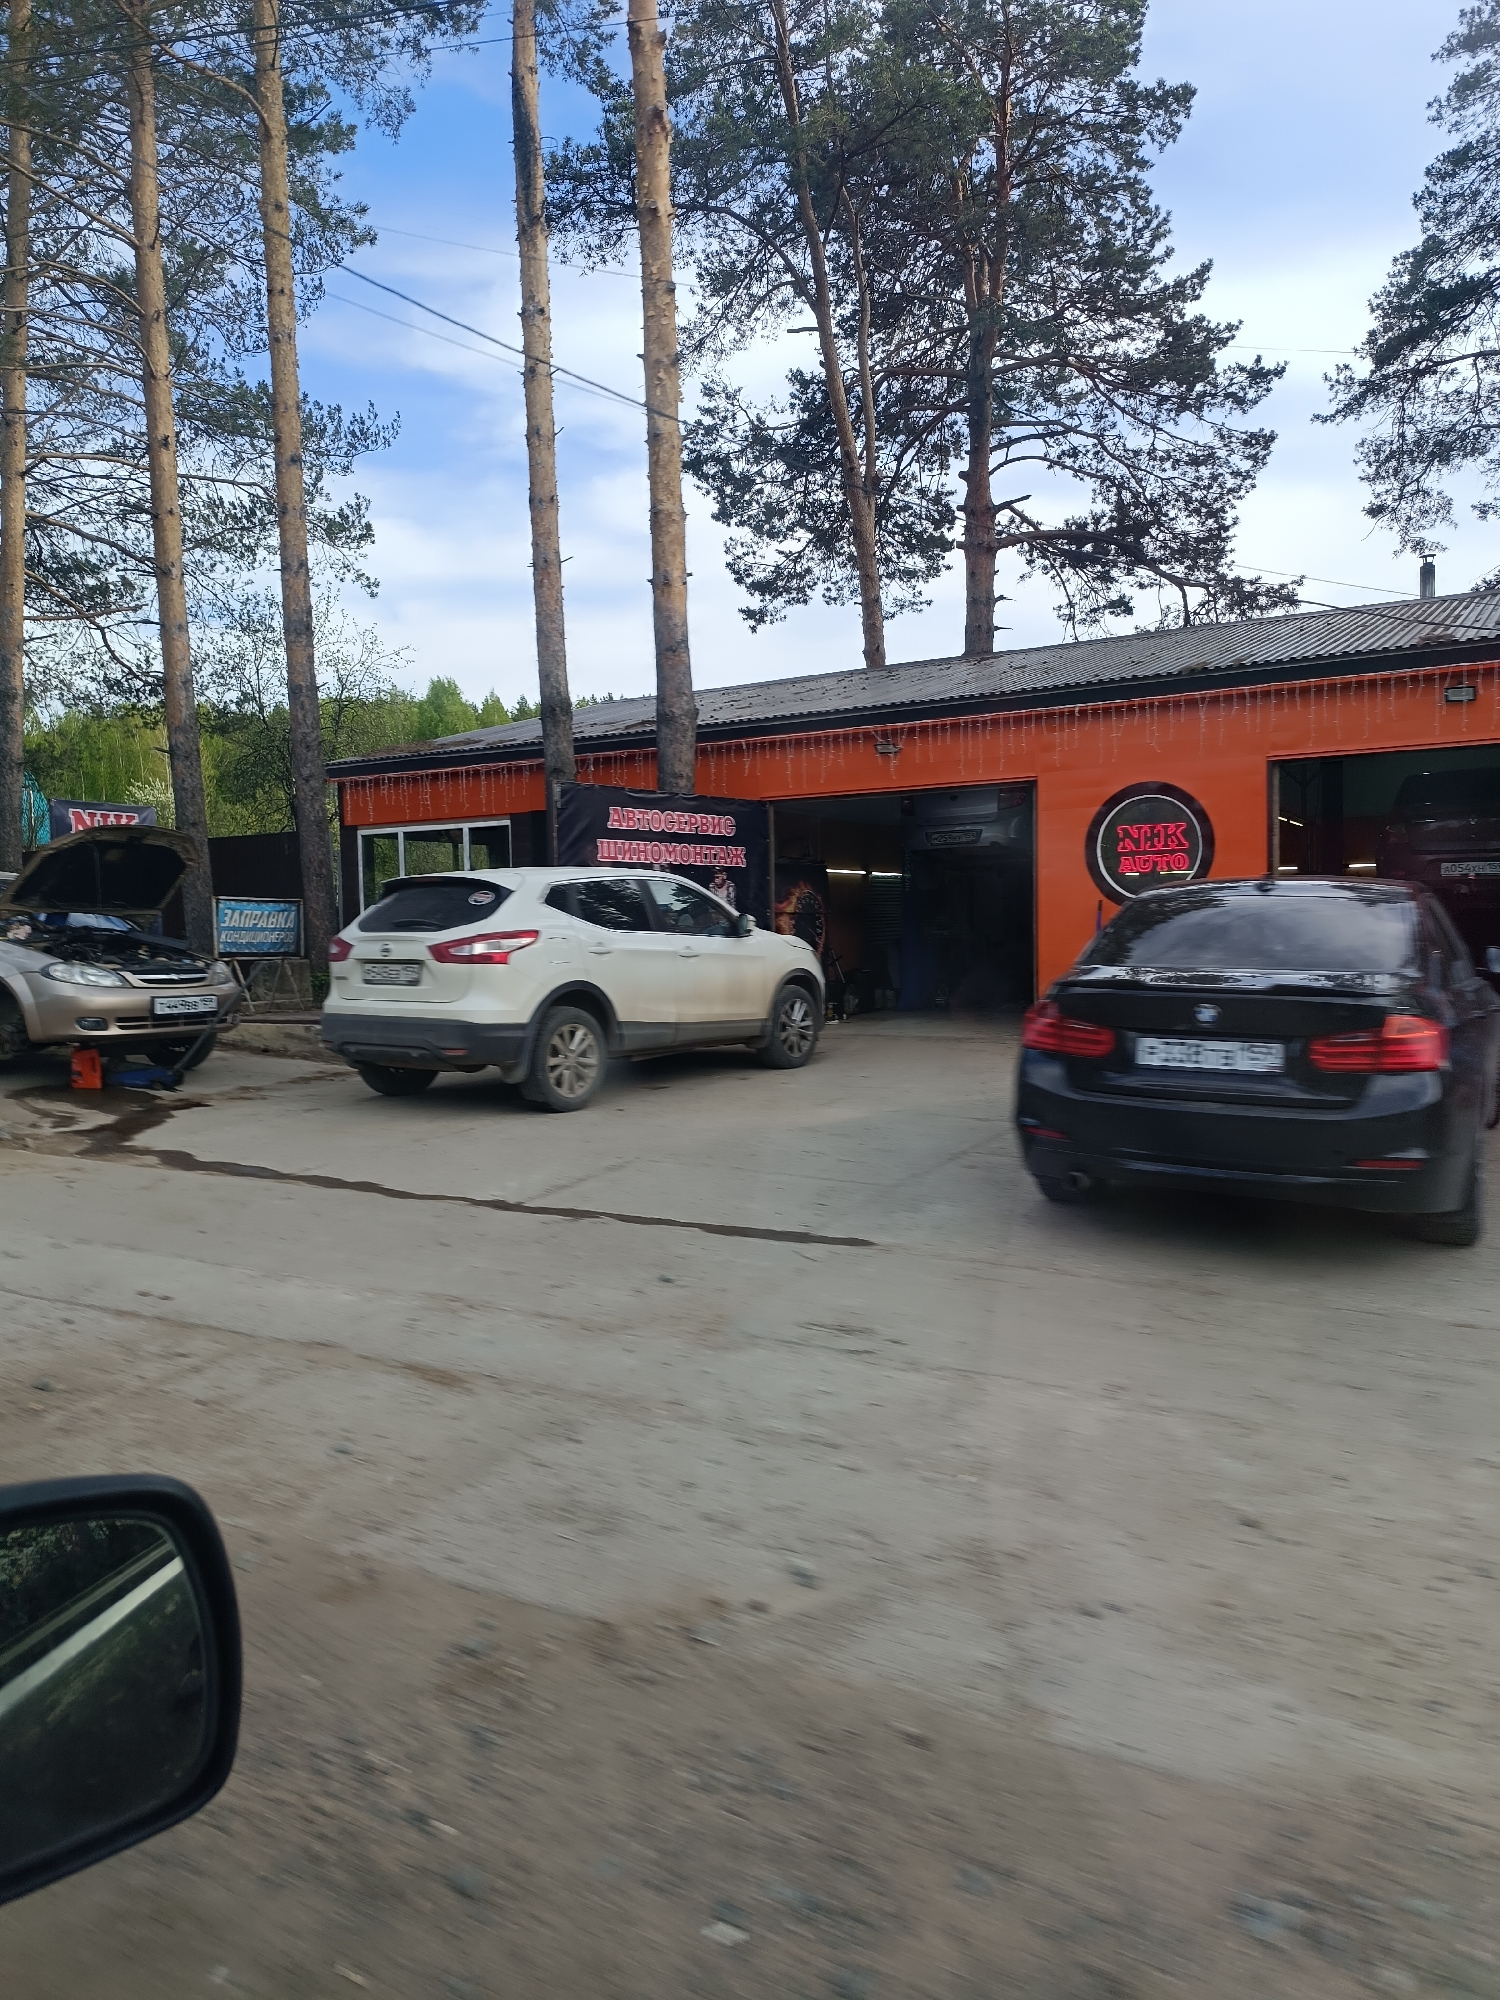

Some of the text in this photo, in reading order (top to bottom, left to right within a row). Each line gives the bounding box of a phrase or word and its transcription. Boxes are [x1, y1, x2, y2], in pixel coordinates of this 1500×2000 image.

[607, 806, 736, 837] АВТОСЕРВИС
[1117, 822, 1189, 852] NIK
[597, 839, 747, 867] ШИНОМОНТАЖ
[1118, 853, 1189, 873] AUTO
[220, 909, 296, 928] ЗАПРАВКА
[220, 930, 295, 944] КОНДИЦИОНЕРОВ
